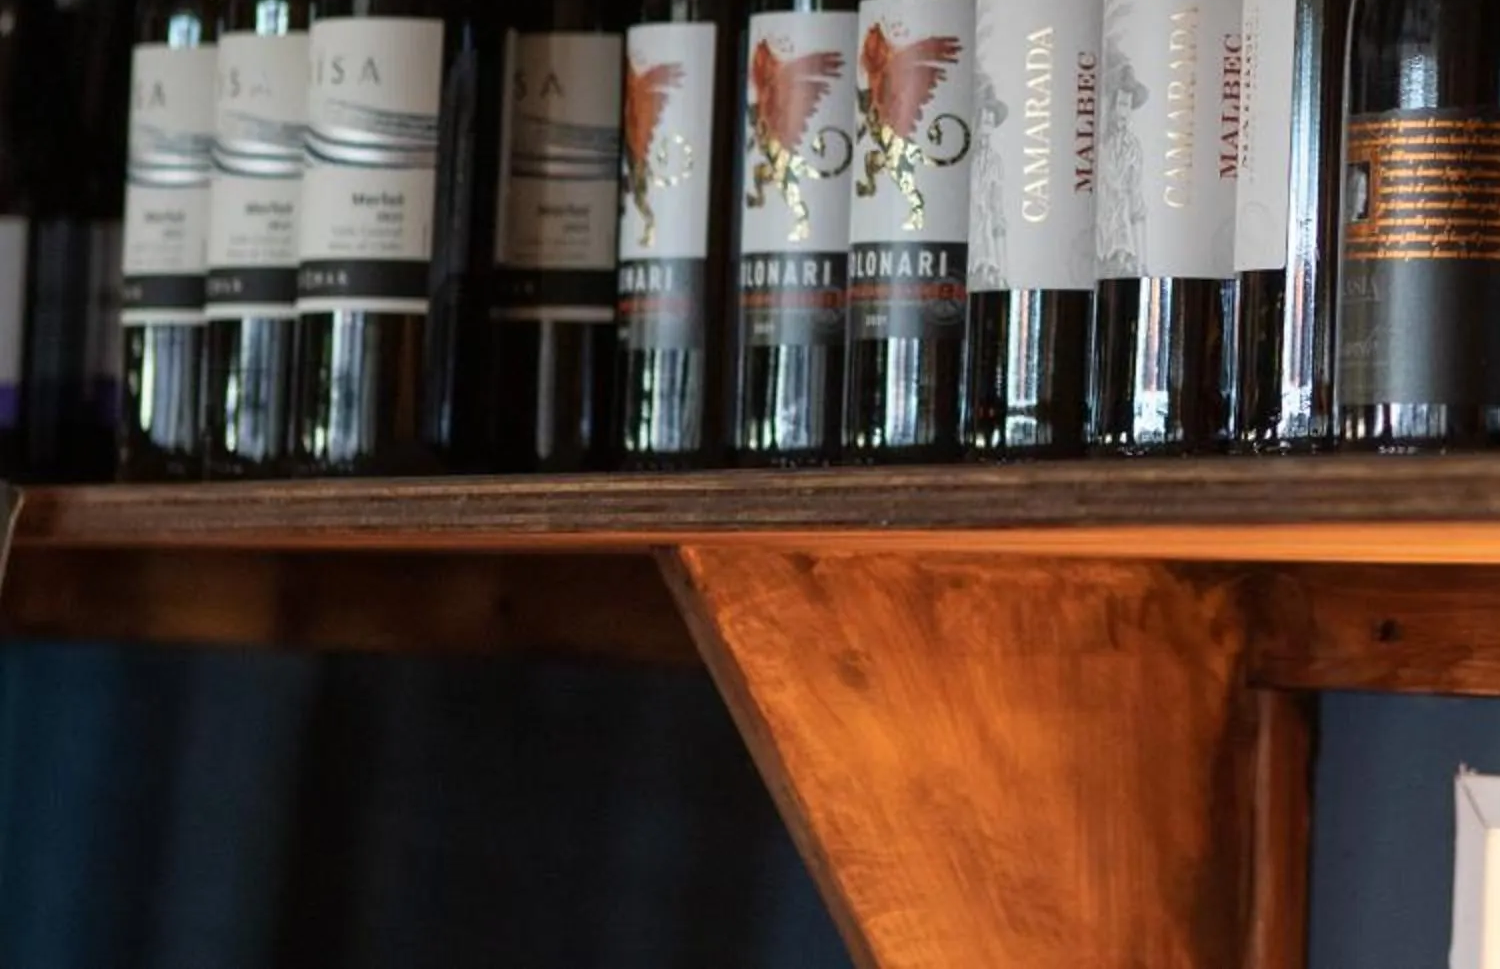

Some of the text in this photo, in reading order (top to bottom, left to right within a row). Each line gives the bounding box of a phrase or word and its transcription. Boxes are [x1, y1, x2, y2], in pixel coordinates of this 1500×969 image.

[1021, 26, 1054, 224] CAMARADA
[1073, 51, 1097, 193] MALBEC
[1162, 5, 1199, 209] CAMARADA
[1219, 33, 1242, 179] MALBEC
